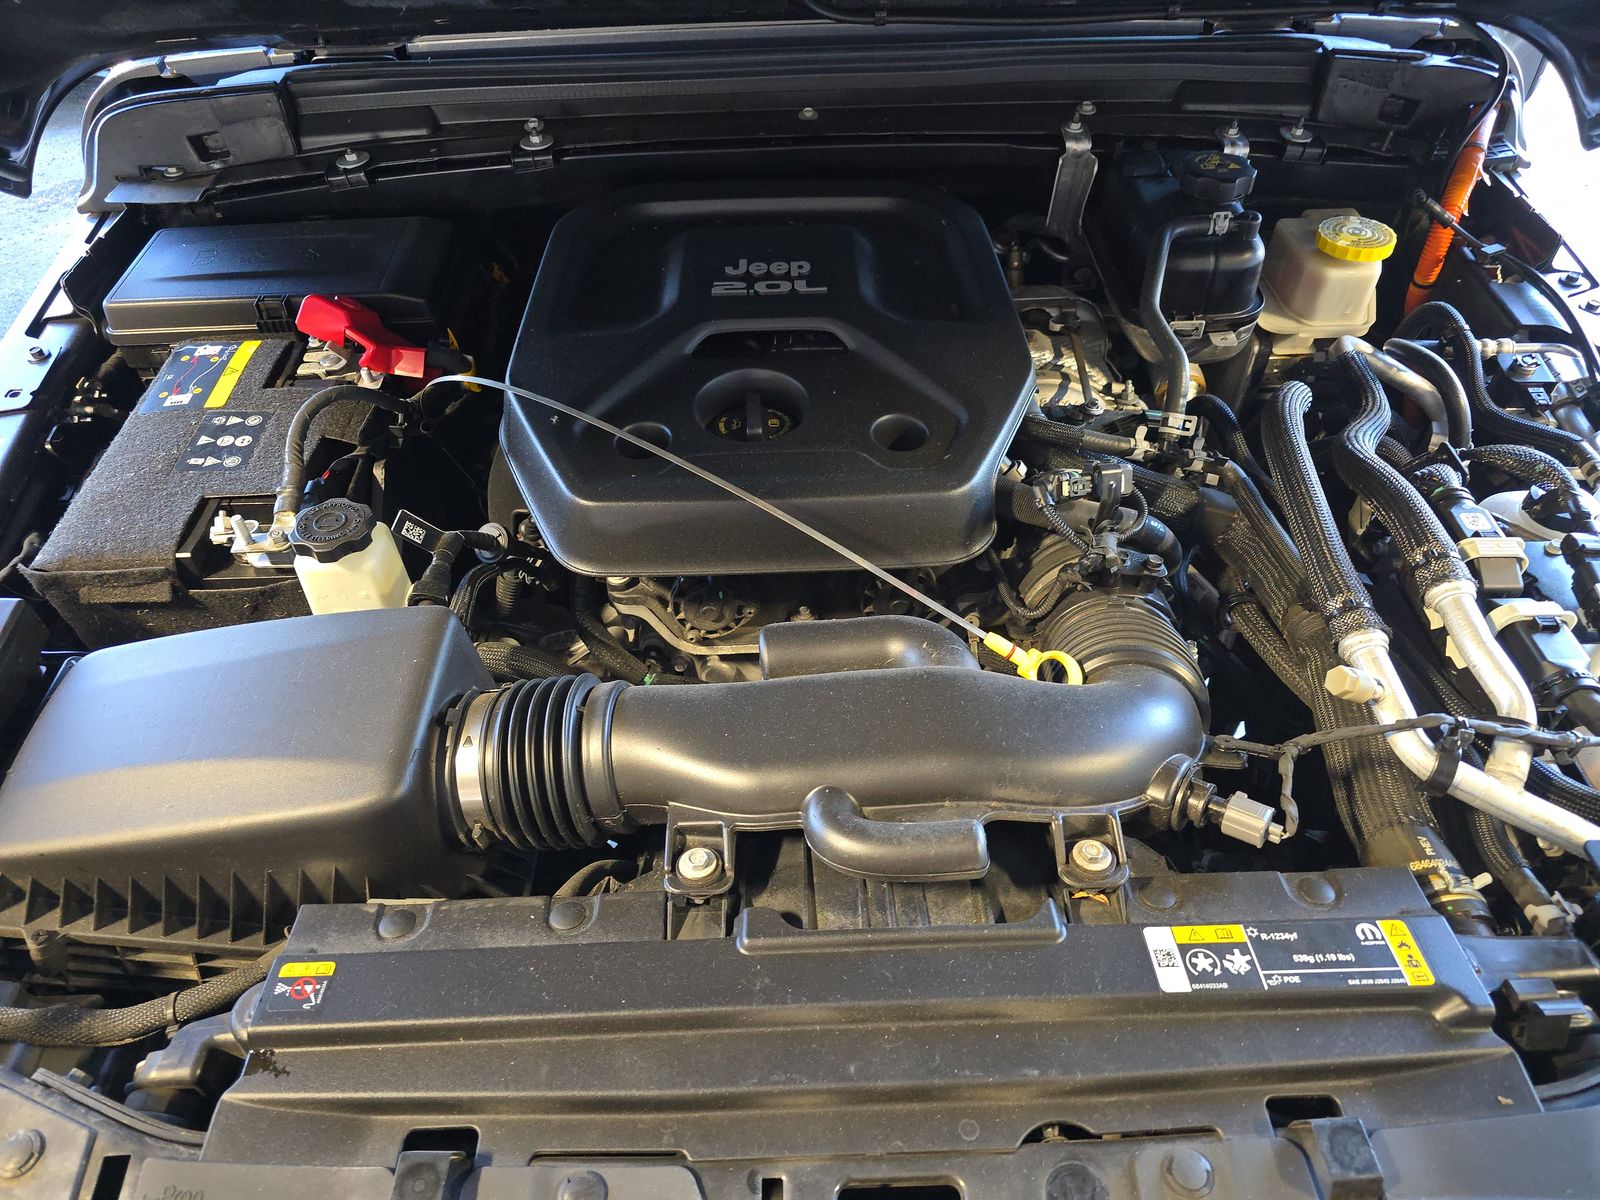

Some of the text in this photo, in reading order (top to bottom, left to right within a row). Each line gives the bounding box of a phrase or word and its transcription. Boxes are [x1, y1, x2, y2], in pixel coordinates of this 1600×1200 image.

[724, 258, 811, 277] Jeep
[711, 280, 828, 296] 2.0L
[1417, 836, 1436, 856] PHEV
[1260, 931, 1298, 942] R-1234yf
[1283, 975, 1302, 984] POE
